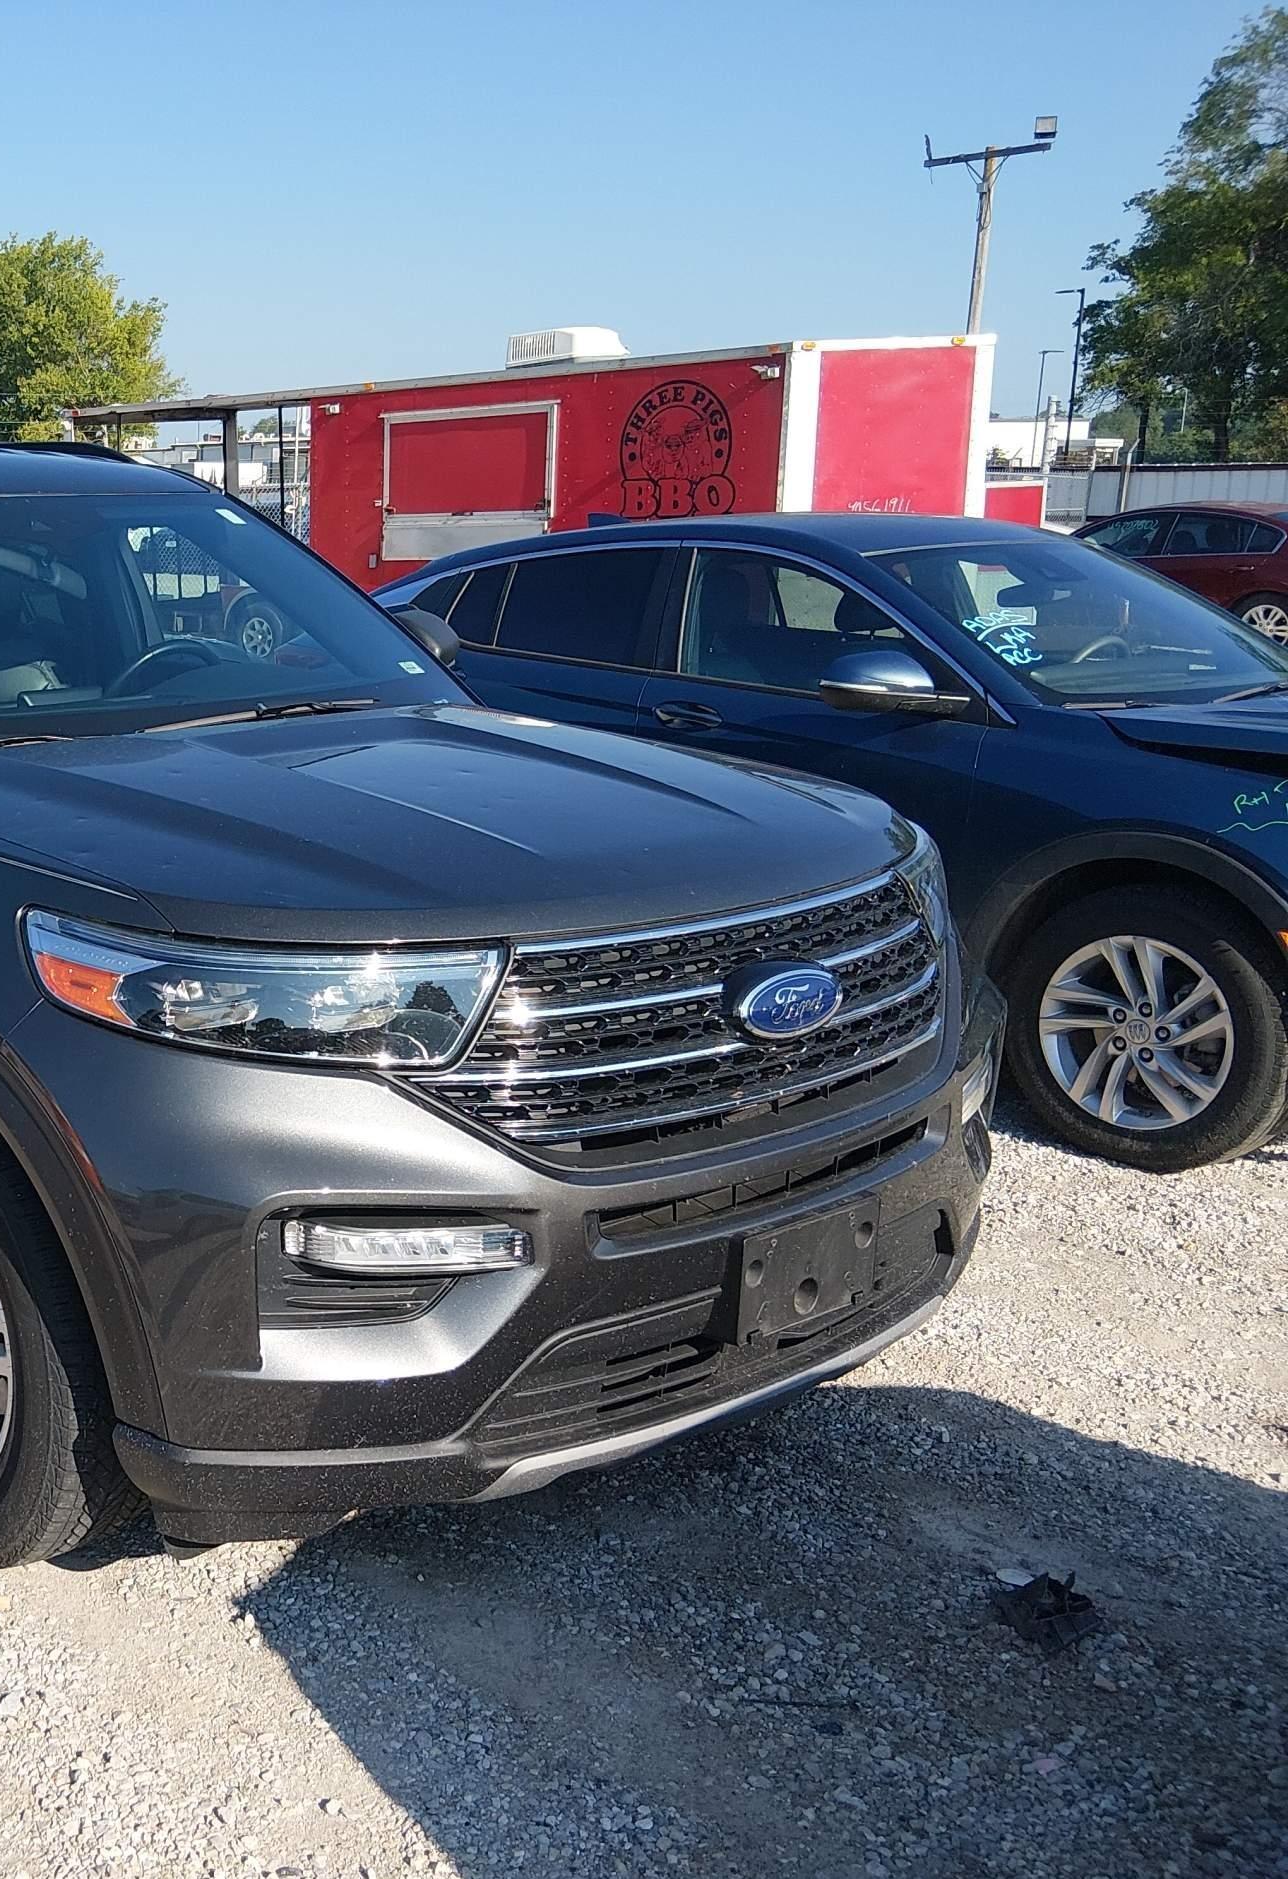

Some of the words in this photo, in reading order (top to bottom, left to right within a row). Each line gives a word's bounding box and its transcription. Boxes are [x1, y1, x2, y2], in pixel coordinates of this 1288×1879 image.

[624, 386, 685, 446] THREE
[692, 389, 728, 442] PIGS
[961, 609, 1028, 633] ADAS
[1001, 647, 1043, 666] ACC
[770, 982, 826, 1026] Ford
